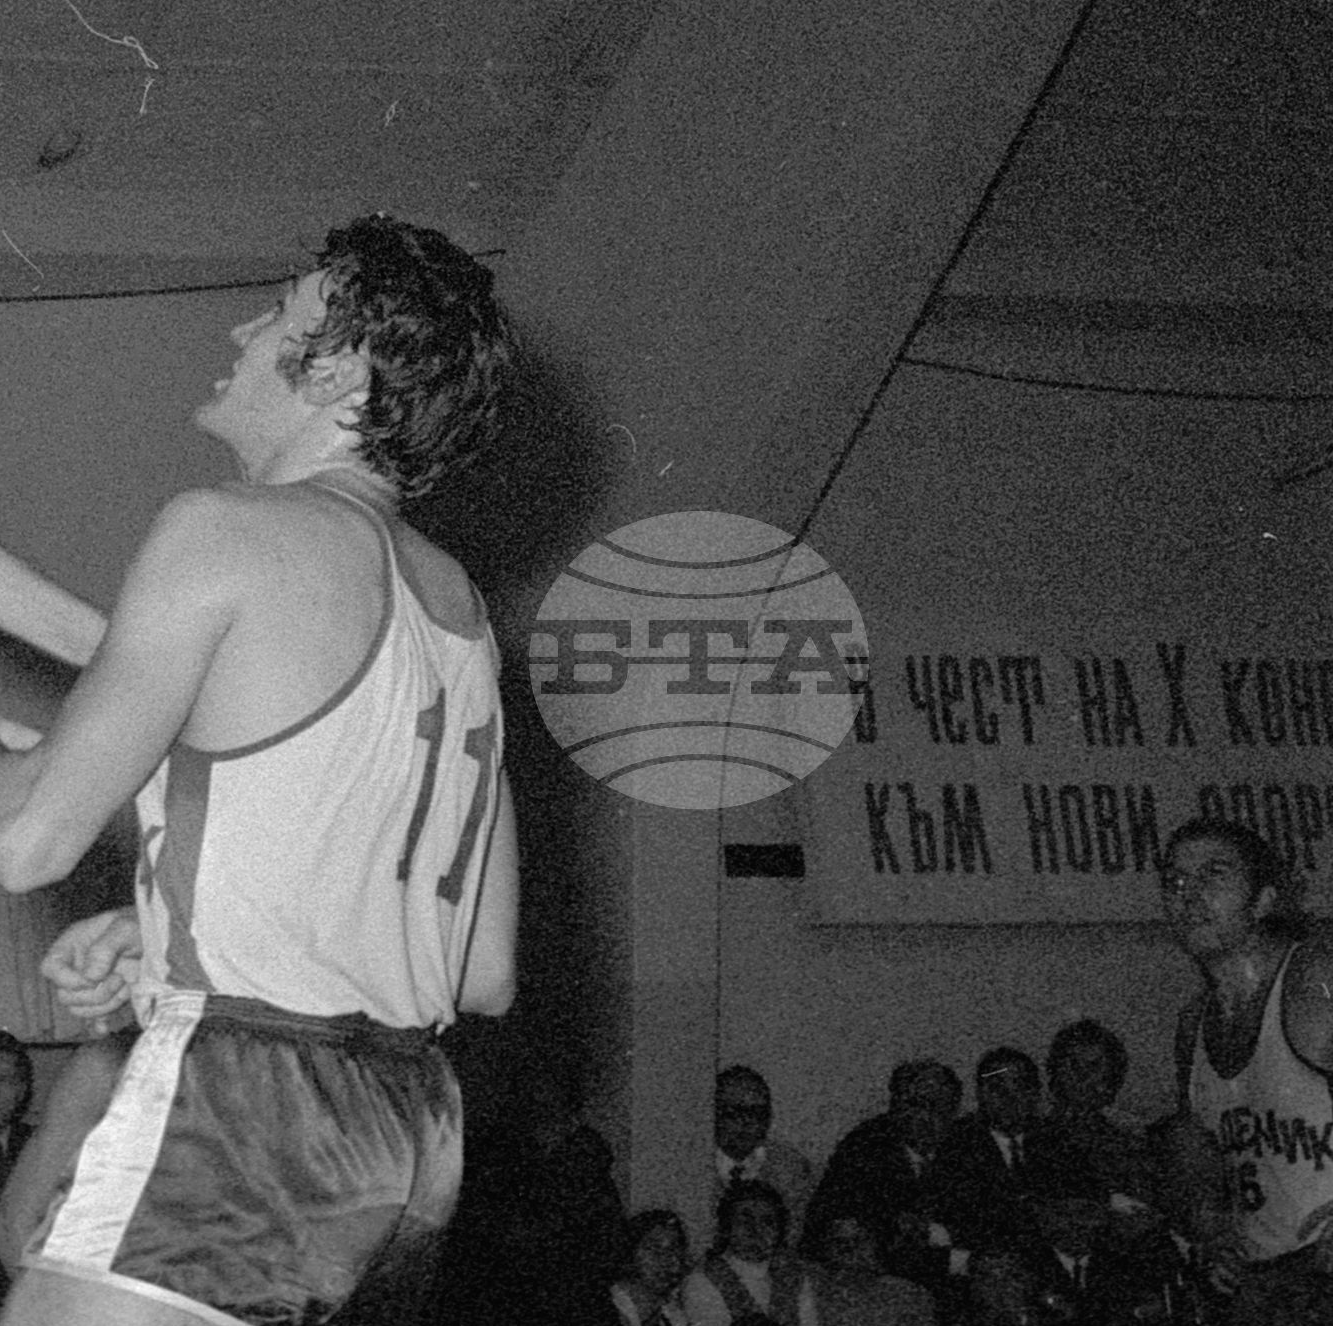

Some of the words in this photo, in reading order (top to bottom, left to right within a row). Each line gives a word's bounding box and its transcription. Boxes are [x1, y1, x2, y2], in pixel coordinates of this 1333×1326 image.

[905, 655, 1046, 746] ЧЕСТ
[1075, 657, 1145, 748] НА
[863, 782, 993, 875] КЪМ
[1021, 782, 1163, 875] НОВИ
